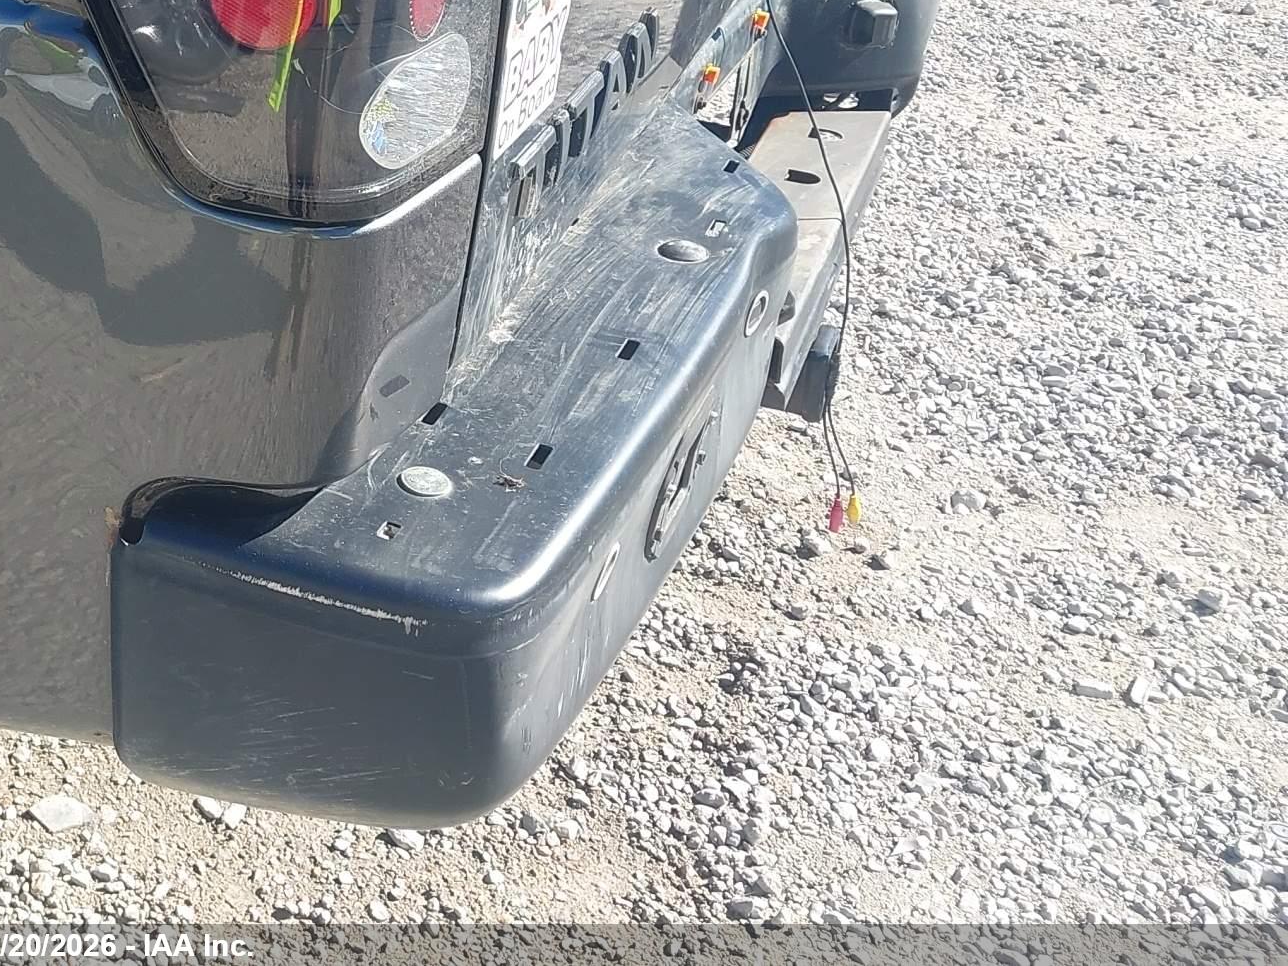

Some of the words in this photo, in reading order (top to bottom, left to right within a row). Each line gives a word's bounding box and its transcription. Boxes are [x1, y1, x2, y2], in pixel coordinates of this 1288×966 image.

[498, 119, 515, 150] On
[518, 74, 557, 131] Board
[503, 5, 568, 113] BABY
[509, 6, 661, 220] TITAN
